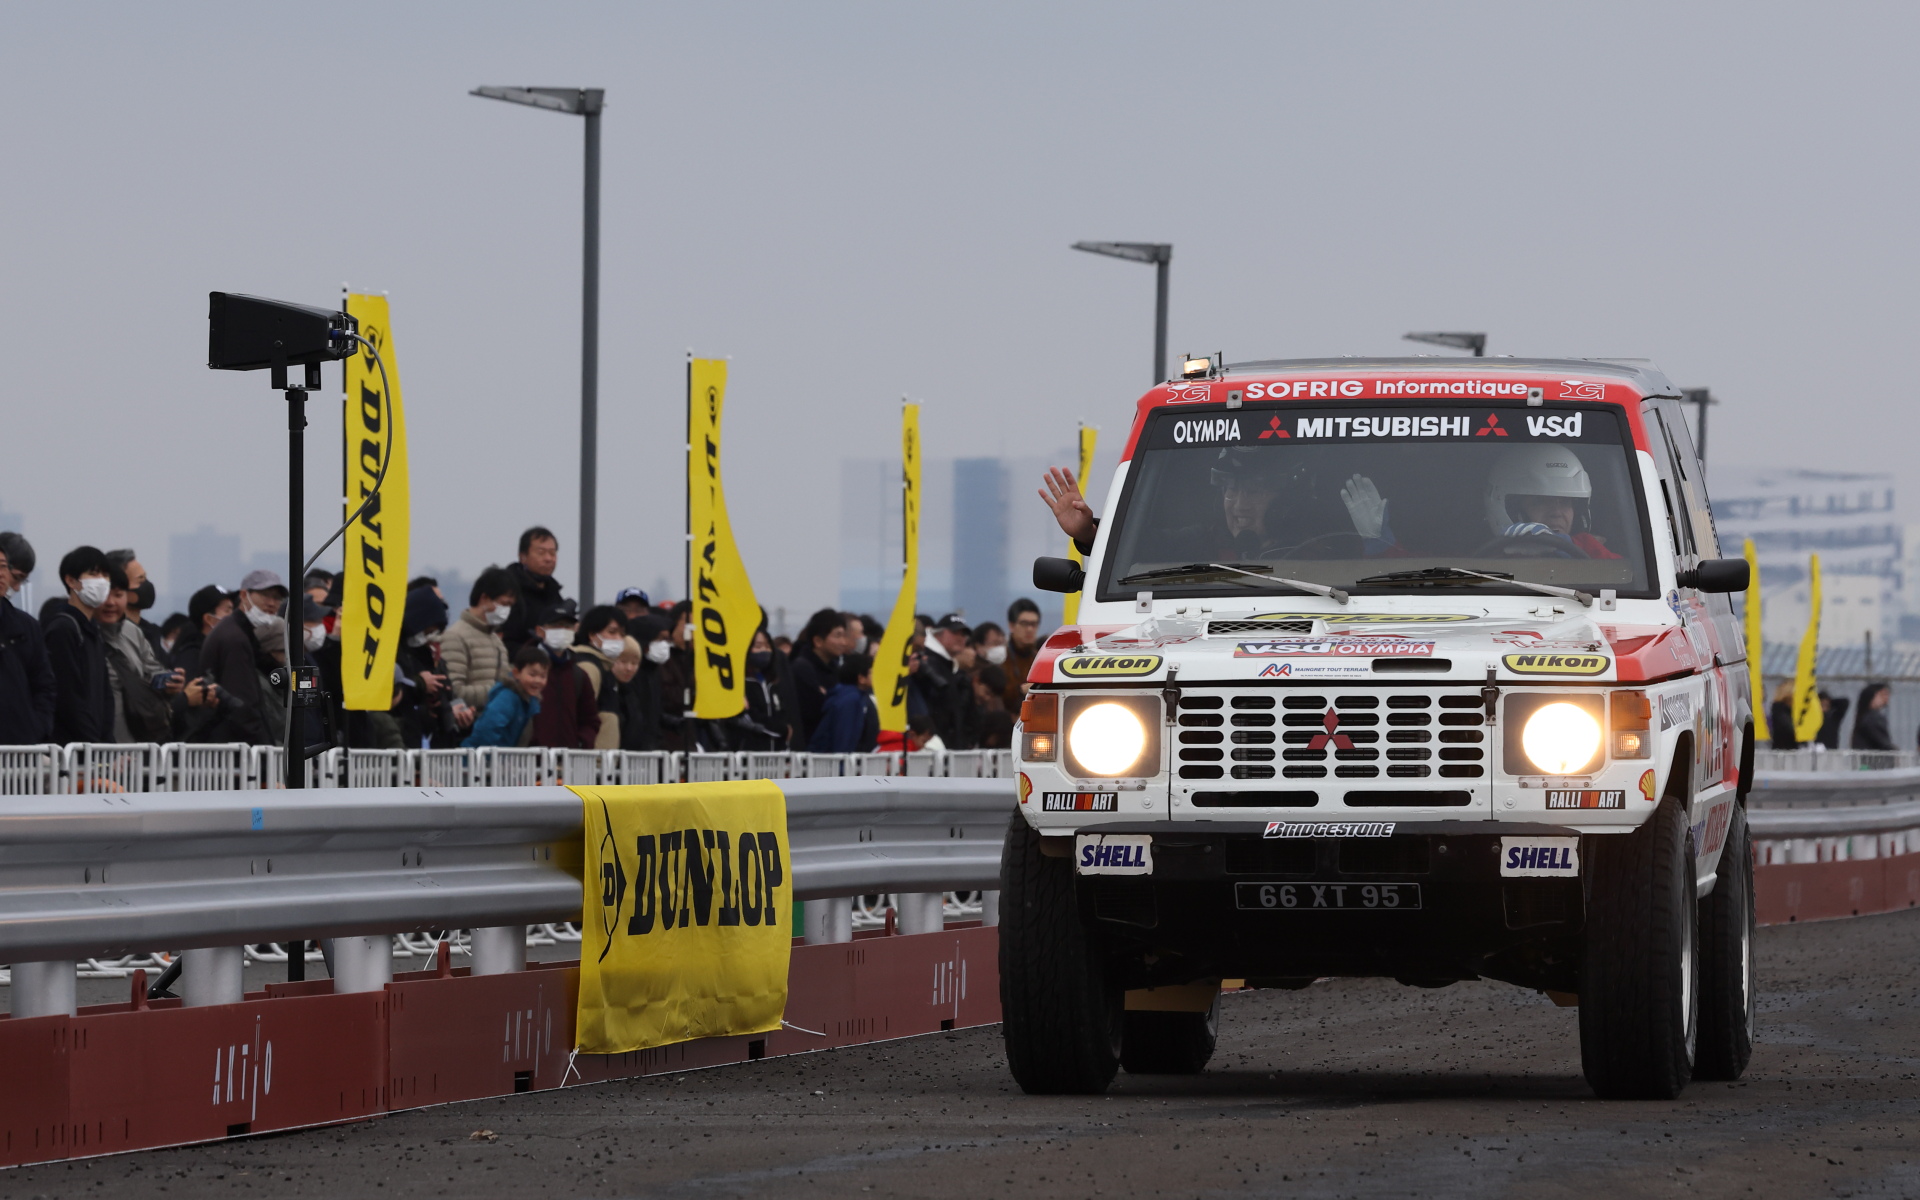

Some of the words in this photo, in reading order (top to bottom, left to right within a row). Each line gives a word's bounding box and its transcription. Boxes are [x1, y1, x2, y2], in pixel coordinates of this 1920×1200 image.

[1246, 380, 1363, 399] SOFRIG
[1375, 380, 1528, 396] Informatique
[1173, 418, 1241, 444] OLYMPIA
[1297, 416, 1470, 438] MITSUBISHI
[1526, 411, 1582, 437] vsd
[359, 379, 386, 681] DUNLOP
[1244, 643, 1332, 654] vsd
[1337, 644, 1430, 655] OLYMPIA
[1071, 656, 1152, 669] Nikon
[1516, 655, 1599, 668] Nikon
[1263, 822, 1396, 838] BRIDGESTONE
[1080, 845, 1145, 867] SHELL
[1506, 847, 1572, 869] SHELL
[628, 829, 782, 935] DUNLOP
[1259, 885, 1297, 908] 66
[1310, 885, 1347, 908] XT
[1361, 885, 1399, 908] 95
